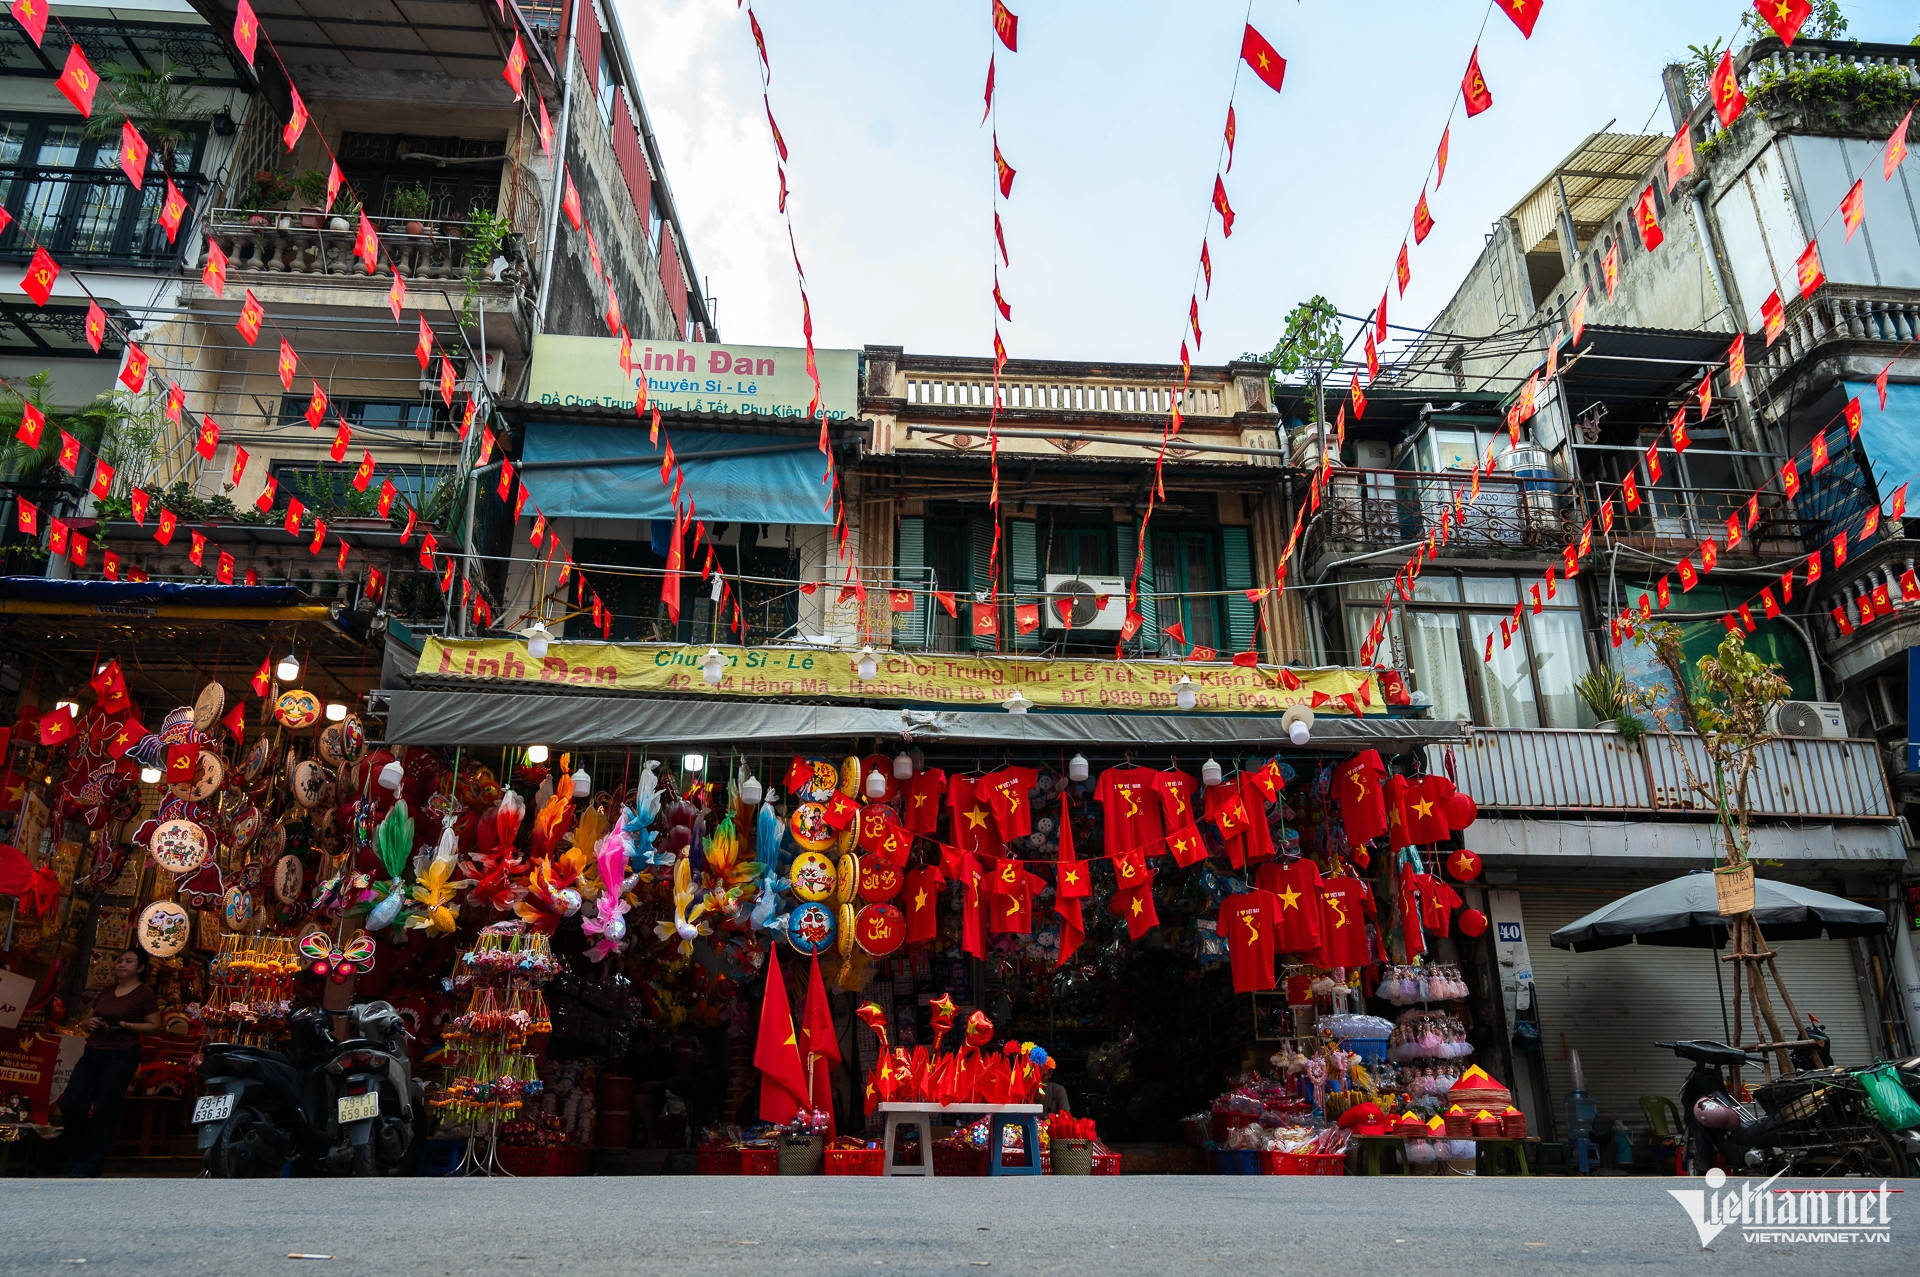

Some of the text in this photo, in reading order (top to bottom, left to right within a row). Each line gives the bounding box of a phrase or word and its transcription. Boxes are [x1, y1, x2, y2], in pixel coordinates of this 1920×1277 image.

[631, 347, 776, 376] inh Đan
[705, 380, 721, 393] Sỉ
[738, 381, 758, 395] Lẻ
[438, 648, 618, 685] Linh Đan
[745, 651, 767, 668] Sỉ
[787, 653, 814, 670] Lẻ
[887, 659, 937, 676] Chơi
[944, 662, 1004, 685] Trung
[1011, 666, 1050, 682] Thu
[1071, 664, 1096, 682] Lễ
[1102, 665, 1135, 684] Tết
[1200, 671, 1246, 689] Kiện
[667, 673, 692, 691] 42
[742, 676, 794, 695] Hàng
[801, 677, 829, 693] Mã
[849, 679, 901, 696] Hoàn
[908, 680, 954, 699] kiếm
[960, 685, 985, 700] Hà
[1100, 689, 1143, 706] 0989
[1238, 693, 1276, 708] 0981
[1500, 925, 1520, 939] 40
[19, 1071, 38, 1082] NAM
[201, 1096, 227, 1110] 29-F1
[343, 1094, 372, 1110] 29-F1
[194, 1107, 229, 1122] 636.38
[341, 1106, 376, 1122] 659.86
